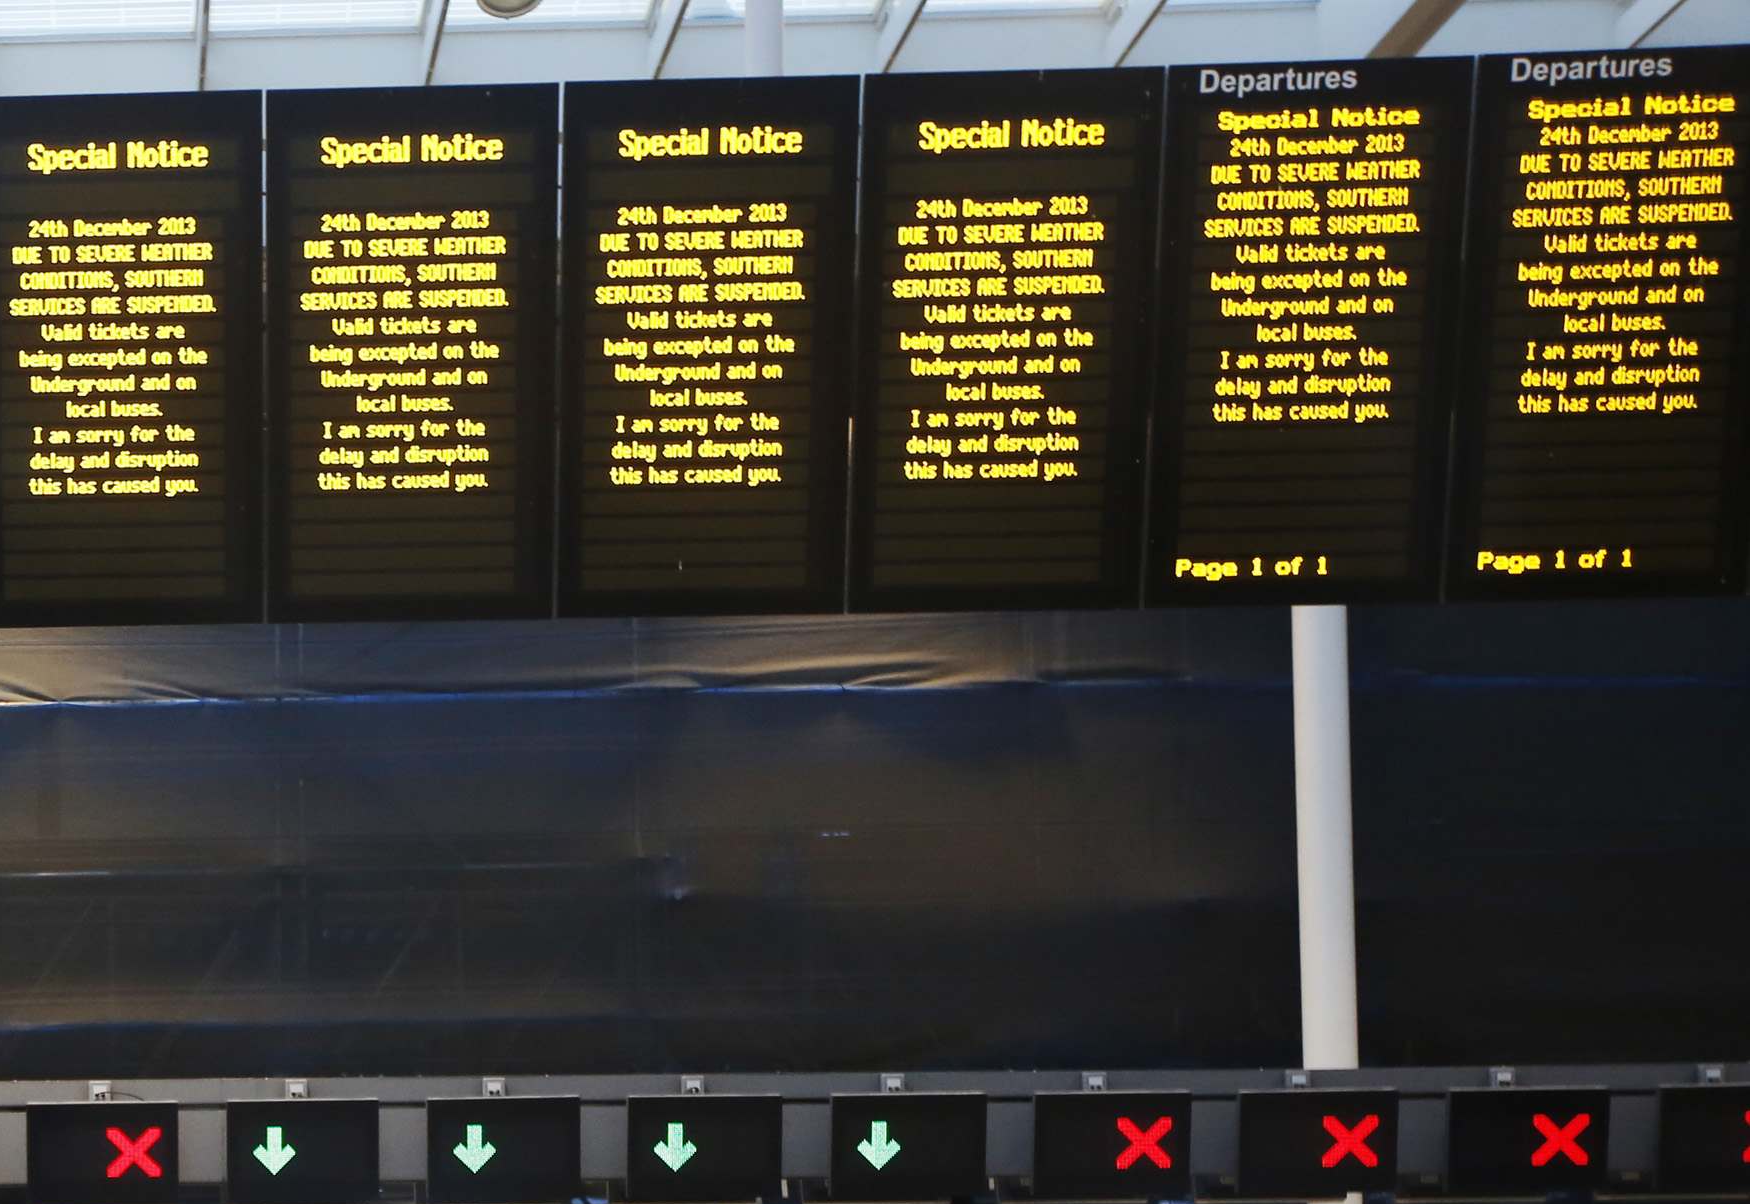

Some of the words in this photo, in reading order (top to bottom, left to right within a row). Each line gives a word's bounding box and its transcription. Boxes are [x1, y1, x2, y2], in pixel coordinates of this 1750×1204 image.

[1200, 67, 1358, 98] Departures
[1510, 54, 1674, 87] Departures
[1218, 108, 1319, 134] Special
[1331, 107, 1420, 127] Notice
[1528, 96, 1631, 123] Special
[1644, 94, 1735, 115] Notice
[619, 128, 709, 160] Special
[720, 126, 802, 154] Notice
[919, 120, 1010, 154] Special
[1021, 118, 1105, 147] Notice
[1540, 126, 1581, 146] 24th
[1588, 124, 1672, 144] December
[1679, 121, 1719, 141] 2013
[28, 143, 117, 174] Special
[127, 141, 208, 168] Notice
[321, 135, 411, 167] Special
[421, 134, 503, 161] Notice
[1520, 154, 1552, 174] DUE
[1559, 153, 1582, 172] TO
[1588, 151, 1652, 171] SEVERE
[1658, 147, 1735, 169] WEATHER
[1526, 179, 1630, 201] CONDITIONS,
[1638, 175, 1722, 196] SOUTHERN
[618, 206, 657, 226] 24th
[663, 205, 743, 224] December
[749, 203, 787, 222] 2013
[1512, 207, 1593, 227] SERVICES
[1600, 205, 1632, 225] ARE
[1638, 202, 1733, 223] SUSPENDED.
[1544, 234, 1587, 253] Valid
[1594, 232, 1659, 252] tickets
[1665, 234, 1697, 249] are
[1518, 262, 1563, 284] being
[1570, 258, 1653, 282] excepted
[1659, 262, 1681, 276] on
[1688, 257, 1719, 275] the
[1528, 286, 1639, 310] Underground
[1645, 284, 1677, 304] and
[1683, 288, 1704, 302] on
[1564, 314, 1605, 333] local
[1611, 313, 1666, 331] buses.
[1526, 342, 1536, 360] I
[1542, 345, 1565, 360] am
[1572, 344, 1622, 362] sorry
[1630, 339, 1660, 357] for
[1668, 337, 1698, 356] the
[1521, 369, 1567, 390] delay
[1574, 366, 1605, 385] and
[1611, 364, 1700, 387] disruption
[1518, 394, 1551, 413] this
[1558, 394, 1589, 412] has
[1596, 391, 1656, 411] caused
[1663, 395, 1697, 414] you.
[1176, 559, 1238, 581] Page
[1252, 557, 1262, 576] 1
[1275, 557, 1303, 575] of
[1317, 556, 1327, 575] 1
[1477, 552, 1540, 574] Page
[1555, 550, 1565, 569] 1
[1578, 549, 1607, 568] of
[1622, 549, 1631, 567] 1
